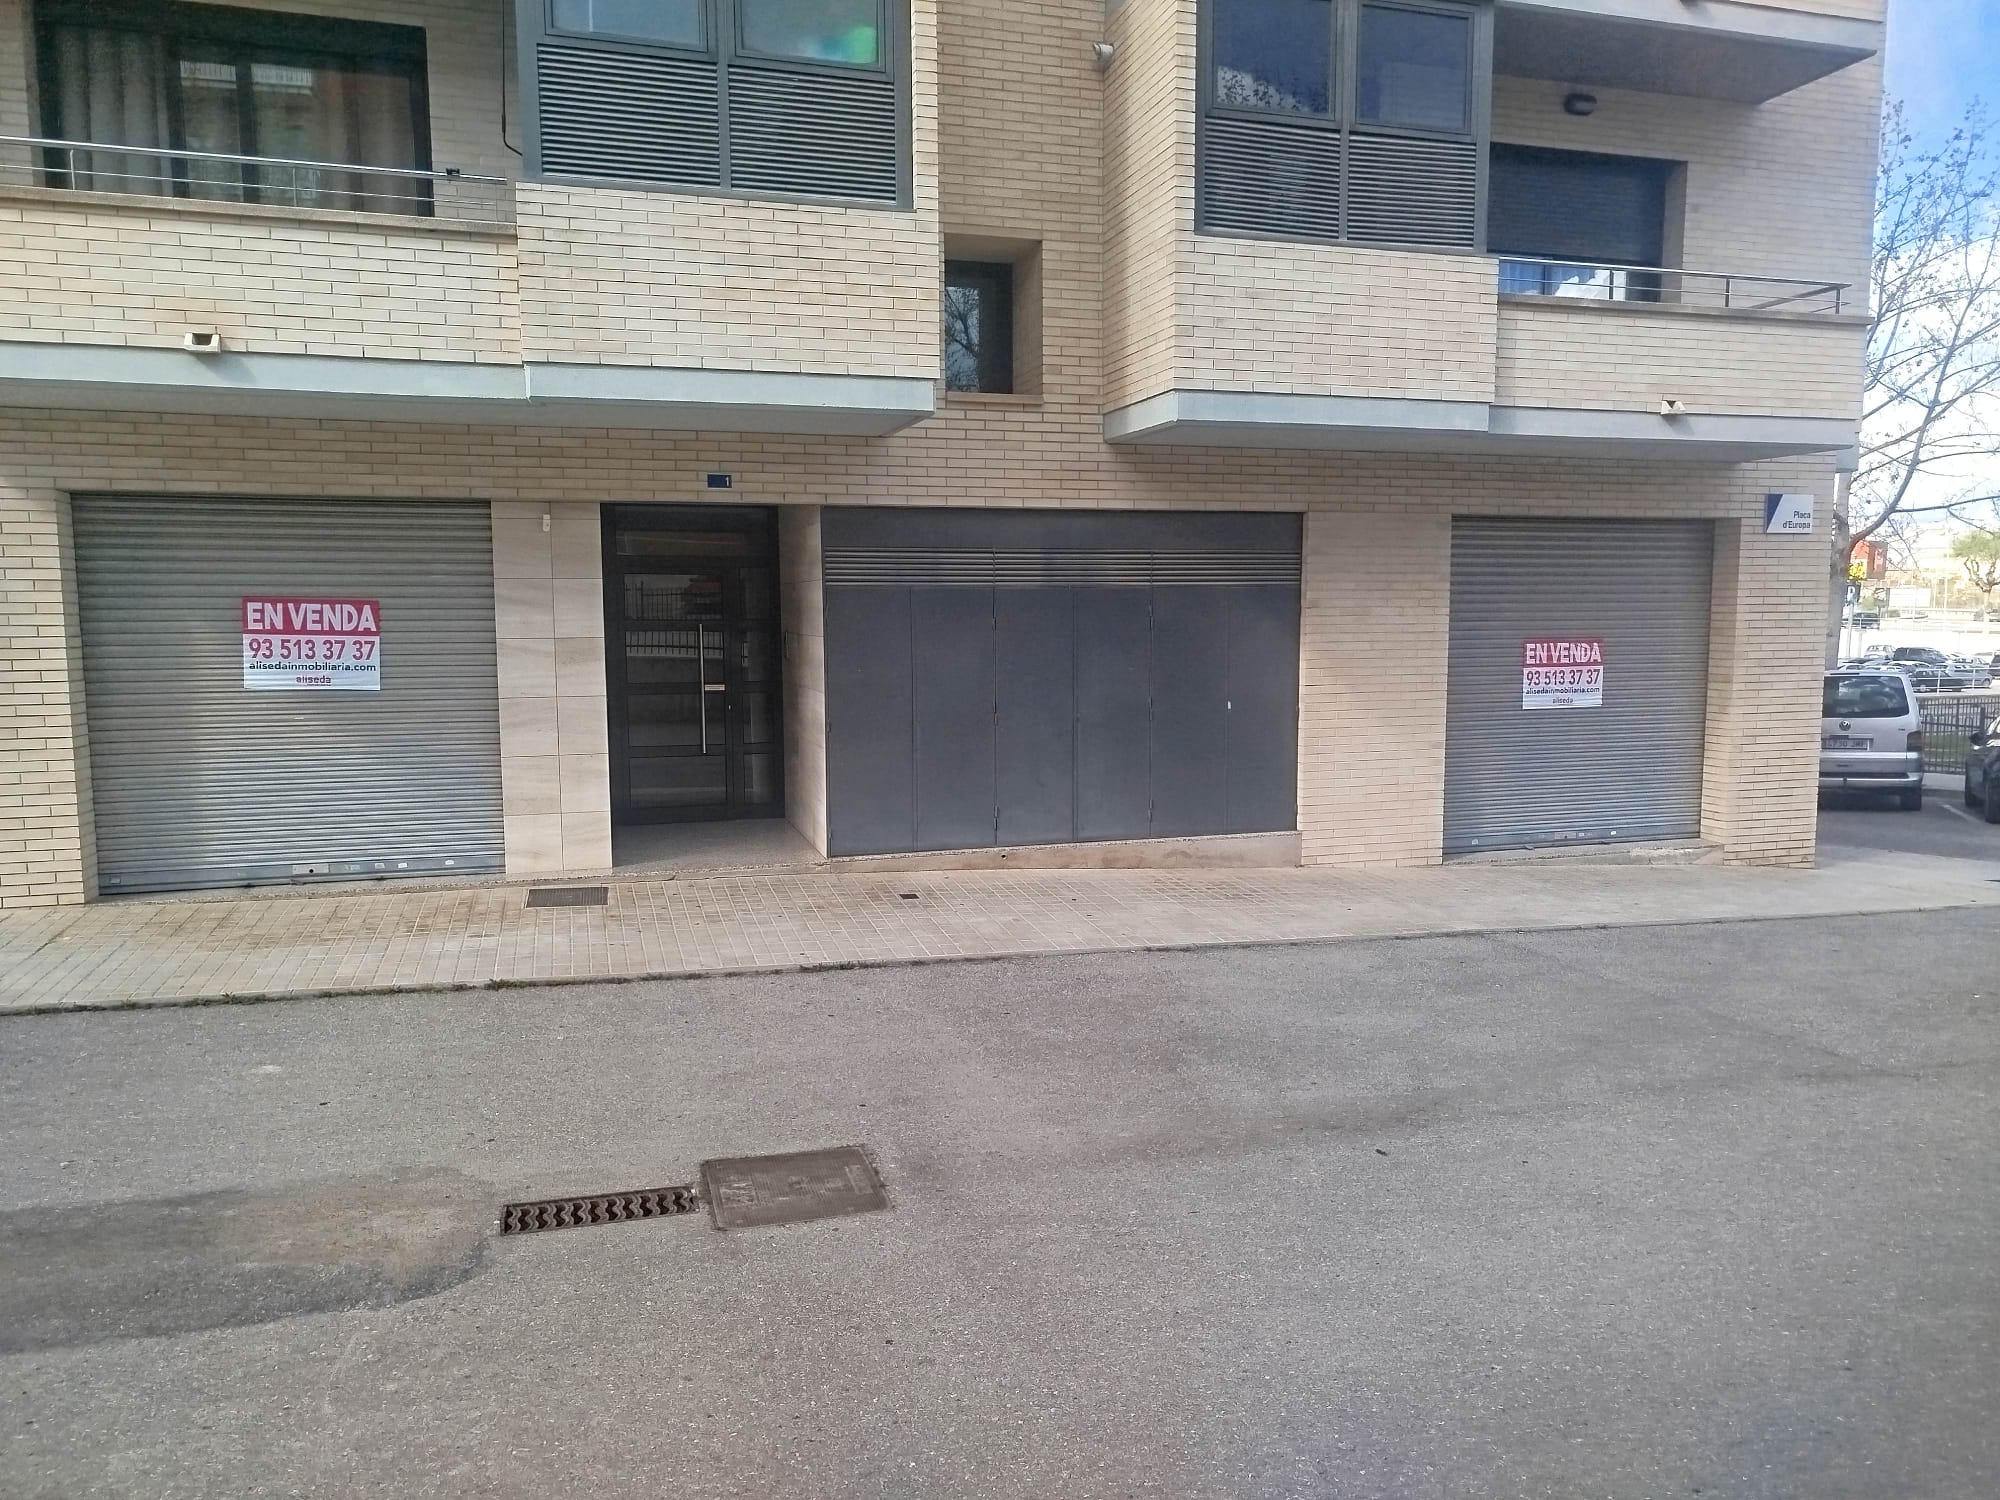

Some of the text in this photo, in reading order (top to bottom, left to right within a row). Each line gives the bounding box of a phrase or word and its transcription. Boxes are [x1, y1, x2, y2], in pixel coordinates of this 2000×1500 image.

[725, 477, 730, 486] 1
[1782, 520, 1811, 530] d'Europa
[247, 602, 377, 632] EN VENDA
[249, 638, 376, 661] 93 513 37 37
[1526, 642, 1602, 664] EN VENDA
[249, 661, 377, 672] alisedainmobiliaria.com
[296, 674, 332, 684] aliseda
[1526, 668, 1601, 686] 93 513 37 37
[1525, 686, 1600, 695] alisedainmobiliaria.com
